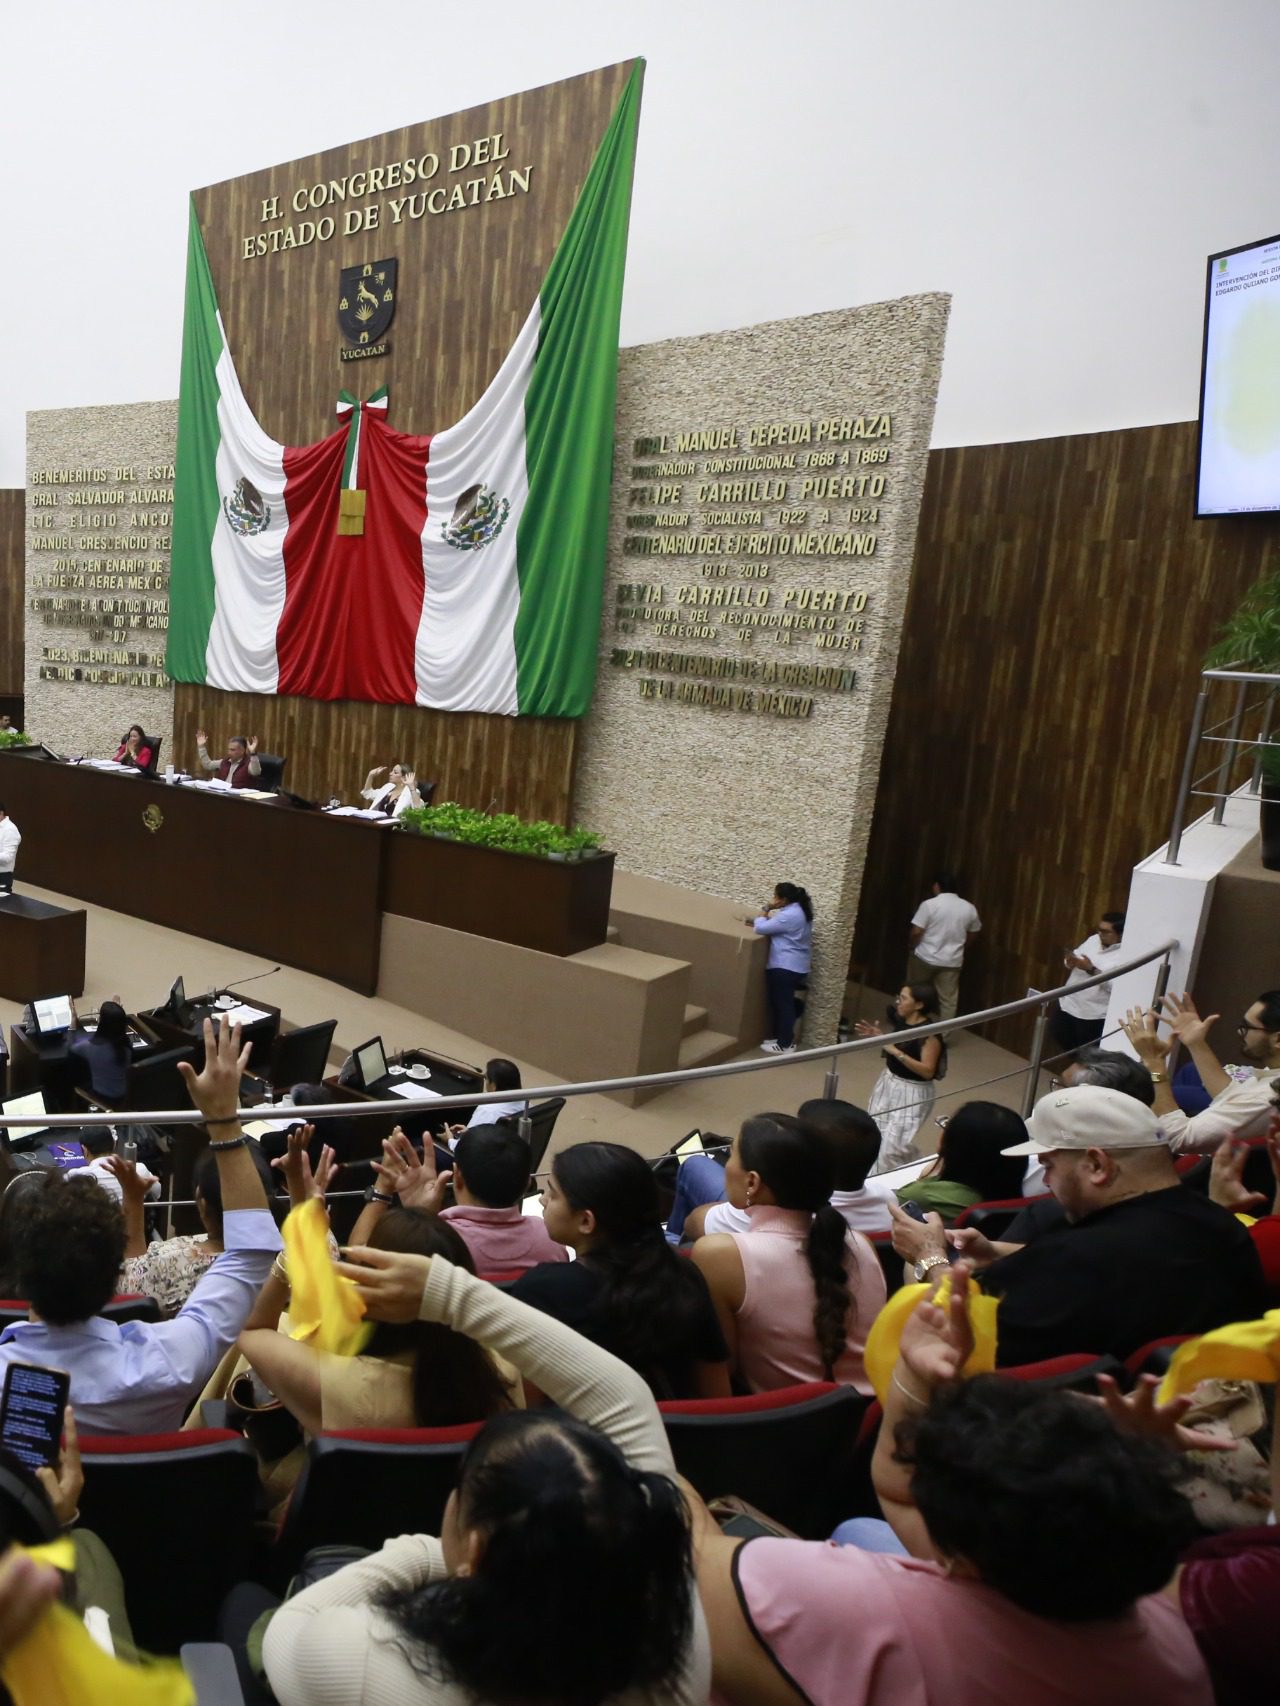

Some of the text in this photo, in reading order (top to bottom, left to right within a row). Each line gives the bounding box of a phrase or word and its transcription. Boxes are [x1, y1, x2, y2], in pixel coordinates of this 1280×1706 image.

[260, 133, 510, 222] H. CONGRESO DEL
[242, 165, 534, 260] ESTADO DE YUCATÁN
[676, 429, 738, 453] MANUEL
[749, 421, 812, 447] CEPEDA
[817, 415, 892, 441] PERAZA
[704, 455, 796, 474] CONSTITUCIONAL
[804, 452, 835, 467] 1868
[841, 451, 851, 465] A
[855, 448, 889, 464] 1869
[32, 469, 107, 484] BENEMERITOS
[115, 467, 137, 481] DEL
[68, 490, 125, 505] SALVADOR
[697, 480, 787, 503] CARRILLO
[800, 475, 886, 499] PUERTO
[69, 513, 117, 528] ELIGIO
[130, 512, 173, 526] ANCO
[702, 511, 763, 526] SOCIALISTA
[778, 510, 806, 524] 1922
[821, 509, 830, 523] A
[848, 508, 880, 523] 1924
[32, 537, 74, 551] MANUEL
[698, 534, 721, 555] DEL
[792, 533, 877, 556] MEXICANO
[150, 560, 163, 573] DE
[737, 564, 769, 578] 2013
[89, 575, 124, 588] AEREA
[676, 585, 769, 607] CARRILLO
[784, 589, 869, 612] PUERTO
[688, 610, 710, 622] DEL
[719, 611, 836, 630] RECONOCIMIENTO
[846, 619, 865, 633] DE
[655, 624, 862, 650] DERECHOS DE LA MUJER
